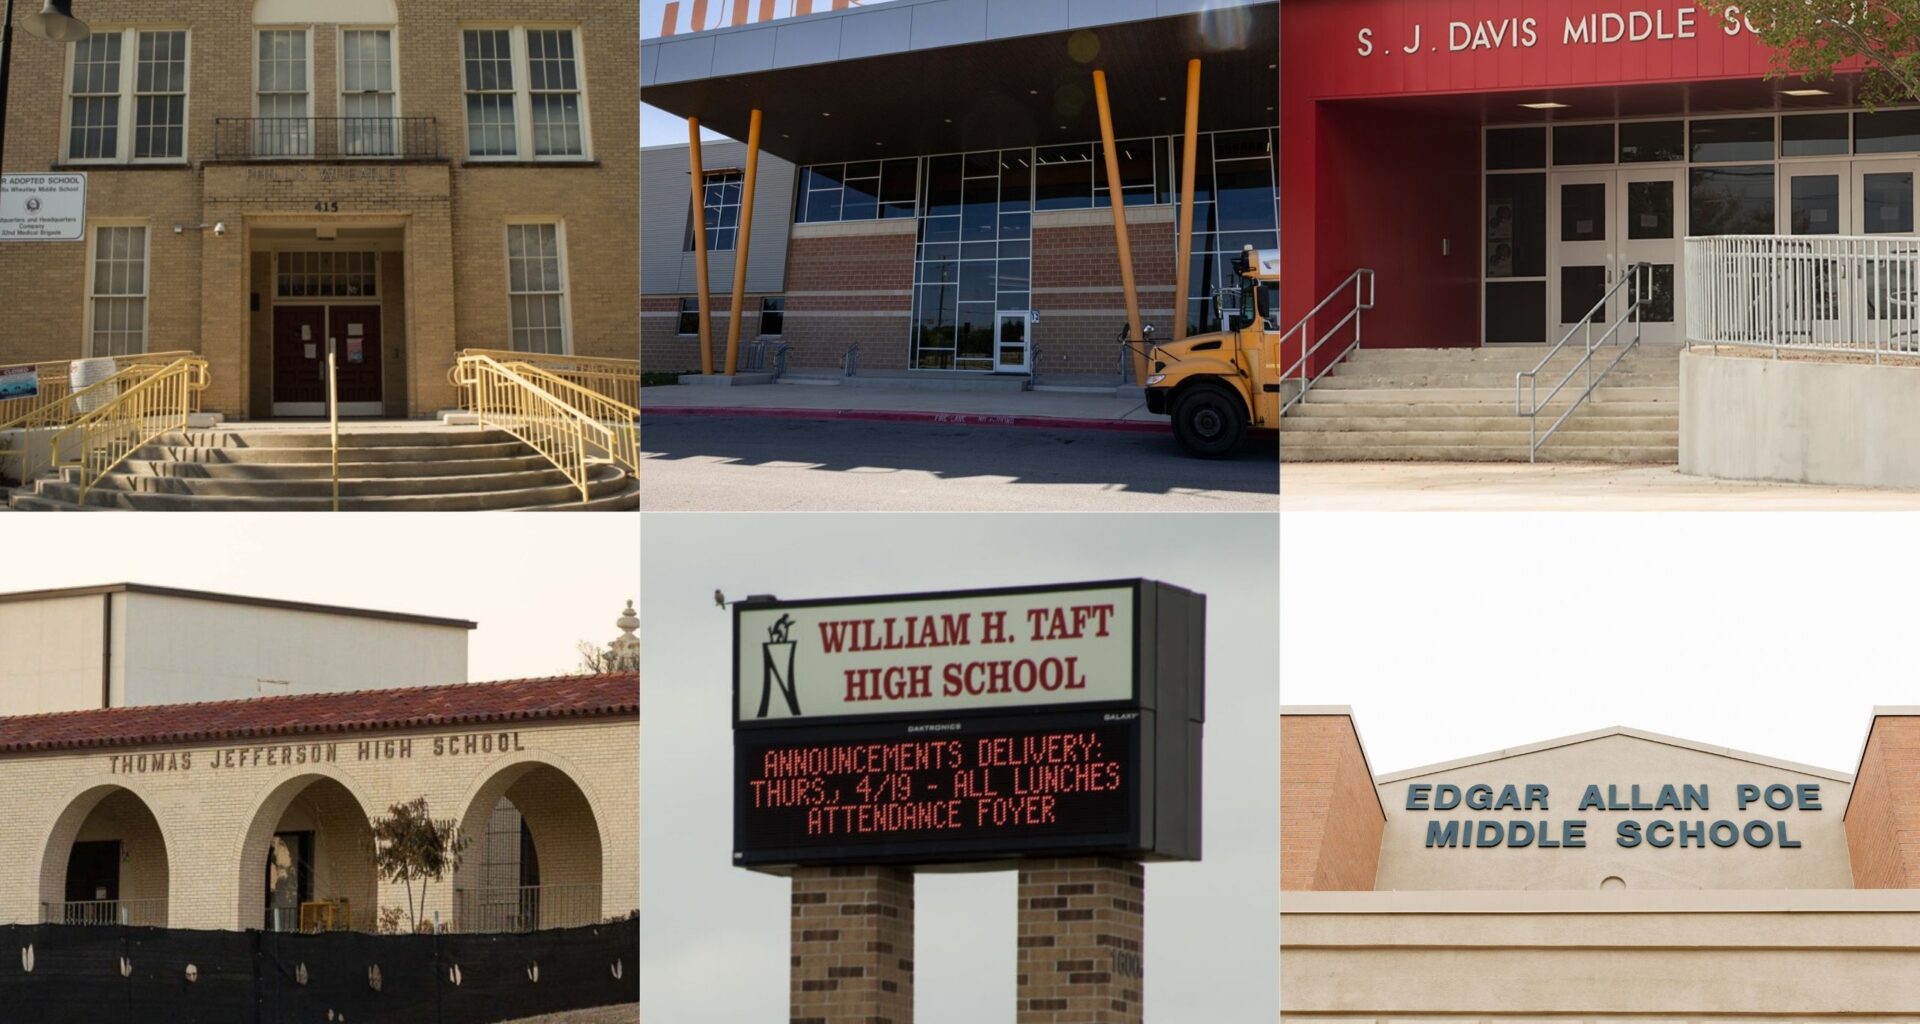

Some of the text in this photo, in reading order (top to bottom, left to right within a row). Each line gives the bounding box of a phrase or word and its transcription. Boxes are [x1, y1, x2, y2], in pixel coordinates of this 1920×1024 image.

[1450, 17, 1538, 52] DAVIS
[1563, 7, 1696, 46] MIDDLE
[10, 177, 45, 185] ADOPTED
[48, 176, 80, 185] SCHOOL
[314, 201, 338, 212] 415
[818, 604, 1115, 654] WILLIAM H. TAFT
[843, 657, 1086, 703] HIGH SCHOOL
[109, 732, 526, 774] THOMAS JEFFERSON HIGH SCHOOL
[764, 733, 1103, 778] ANNOUNCEMENTS DELIVERY:
[855, 773, 912, 803] 4/19
[953, 770, 998, 799] ALL
[1014, 762, 1121, 796] LUNCHES
[1405, 784, 1823, 811] EDGAR ALLAN POE
[808, 796, 1056, 835] ATTENDANCE FOYER
[1425, 820, 1802, 848] MIDDLE SCHOOL
